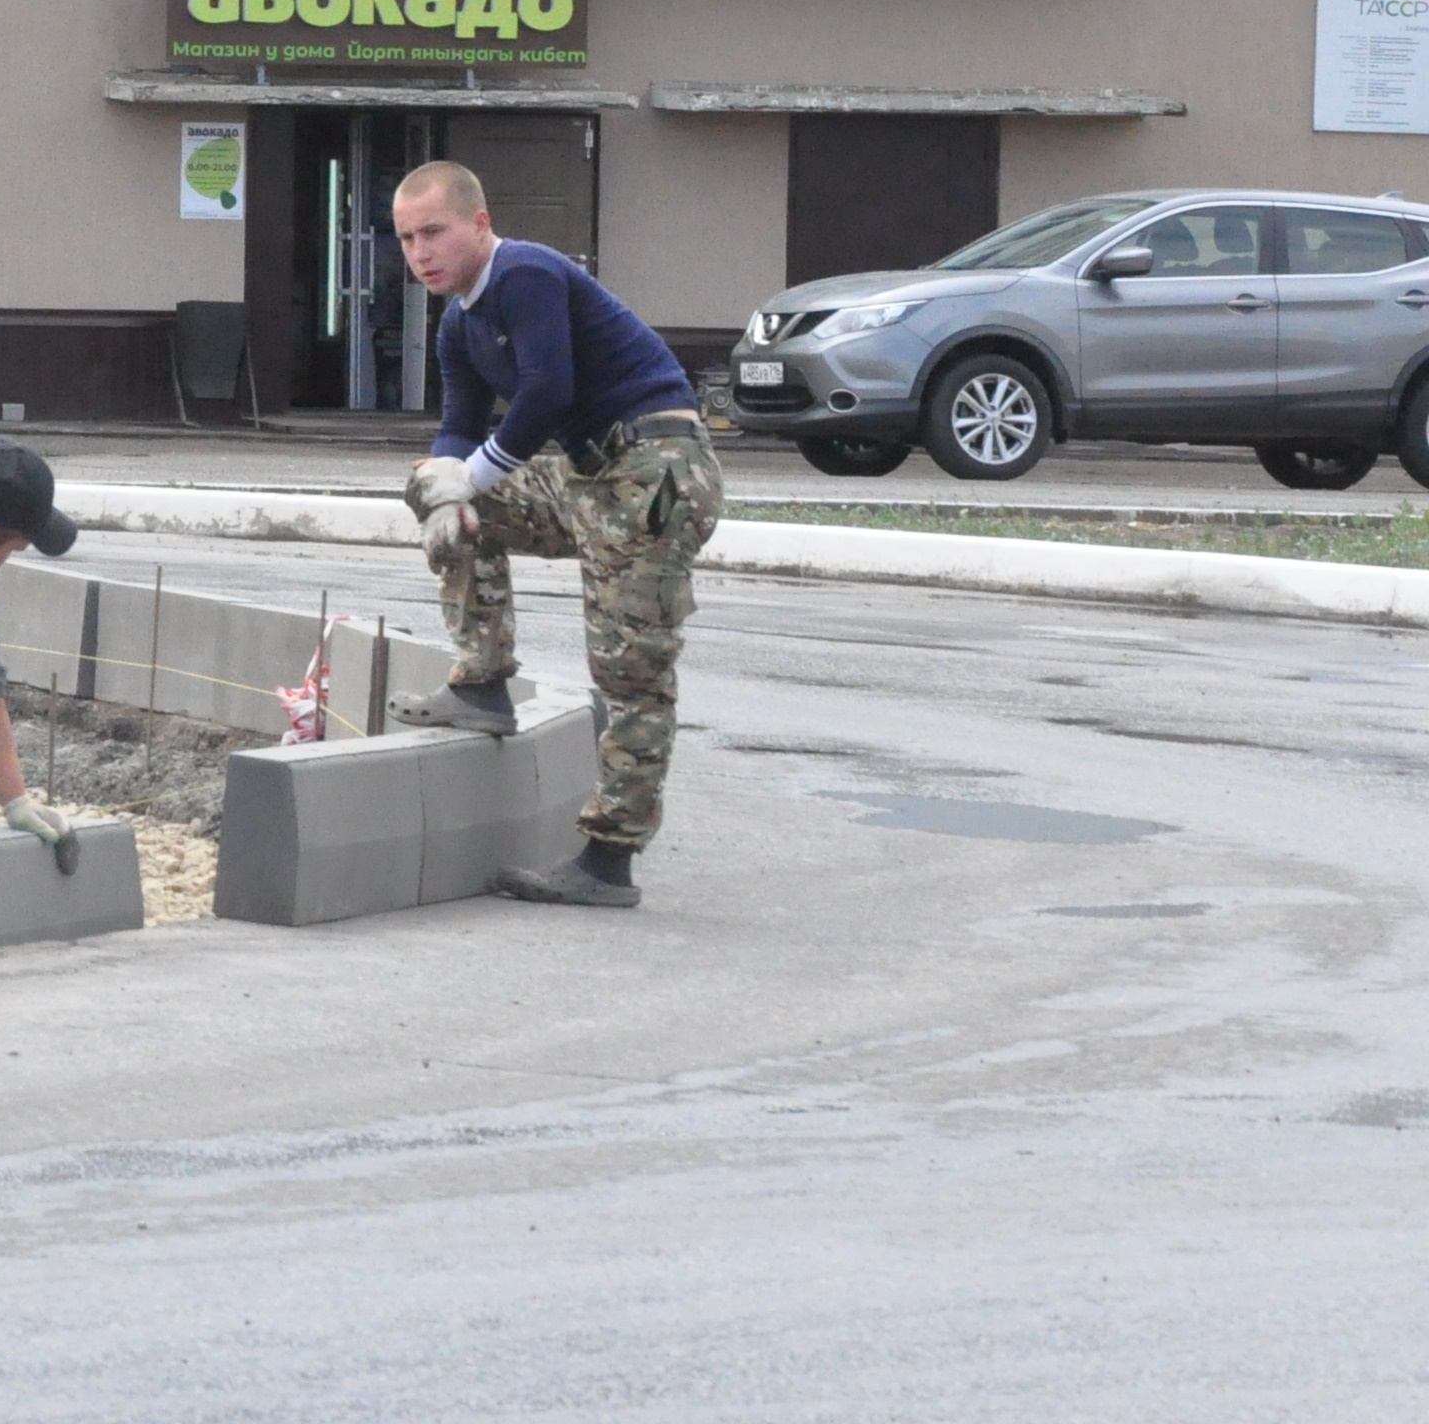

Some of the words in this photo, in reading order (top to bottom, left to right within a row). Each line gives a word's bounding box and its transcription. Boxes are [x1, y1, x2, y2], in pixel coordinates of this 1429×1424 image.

[173, 41, 260, 59] Магазин
[266, 45, 278, 61] у
[283, 44, 335, 61] дома
[347, 40, 406, 62] Йорт
[411, 46, 513, 63] янындагы
[519, 45, 587, 63] кибет
[187, 127, 239, 139] авокадо
